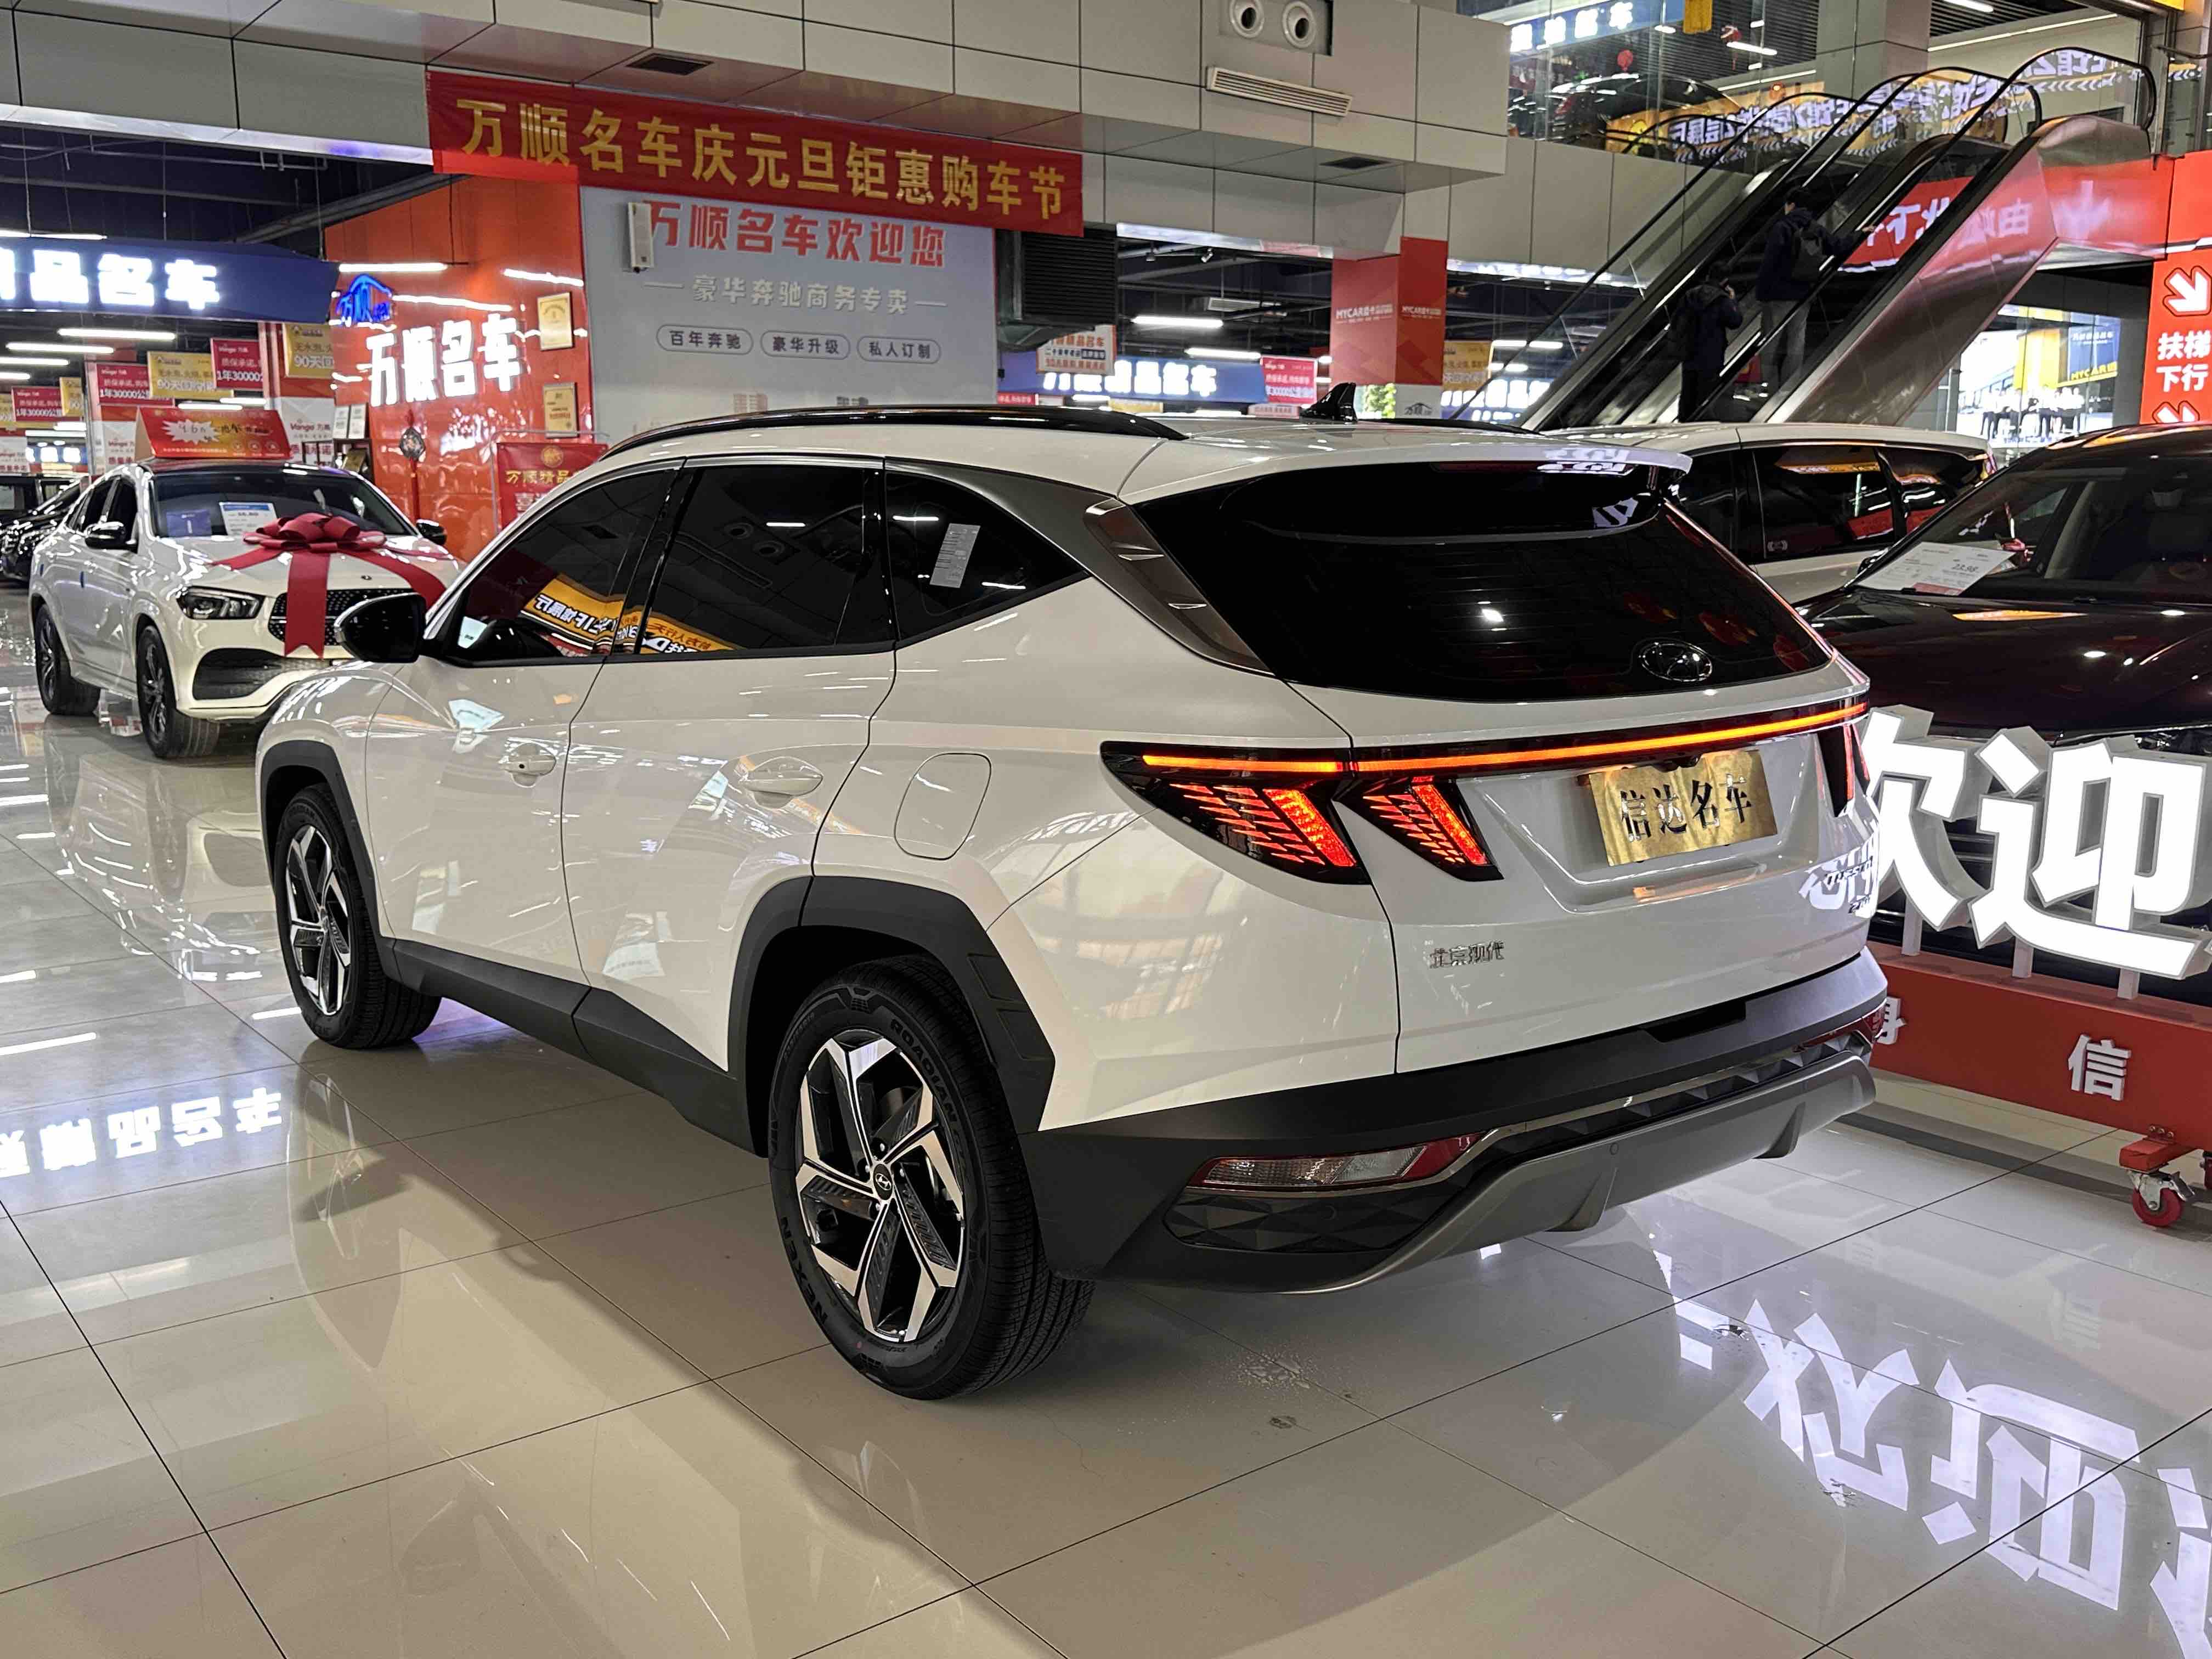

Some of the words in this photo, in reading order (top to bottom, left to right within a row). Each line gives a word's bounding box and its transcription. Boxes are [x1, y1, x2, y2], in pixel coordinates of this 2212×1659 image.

[457, 98, 1064, 220] 万顺名车庆元旦钜惠购车节
[642, 200, 947, 269] 万顺名车欢迎您
[0, 247, 221, 310] 品名车
[692, 275, 909, 315] 豪华奔驰商务专卖
[366, 314, 521, 407] 万顺名车
[670, 330, 742, 350] 百年奔驰
[772, 336, 840, 354] 豪华升级
[868, 341, 932, 359] 私人订制
[2157, 330, 2210, 358] 扶梯
[2155, 364, 2209, 392] 下行
[1620, 773, 1753, 843] 信达名车
[1430, 939, 1505, 969] 北京现代
[2068, 1034, 2132, 1102] 信
[780, 1216, 828, 1324] NEXEN
